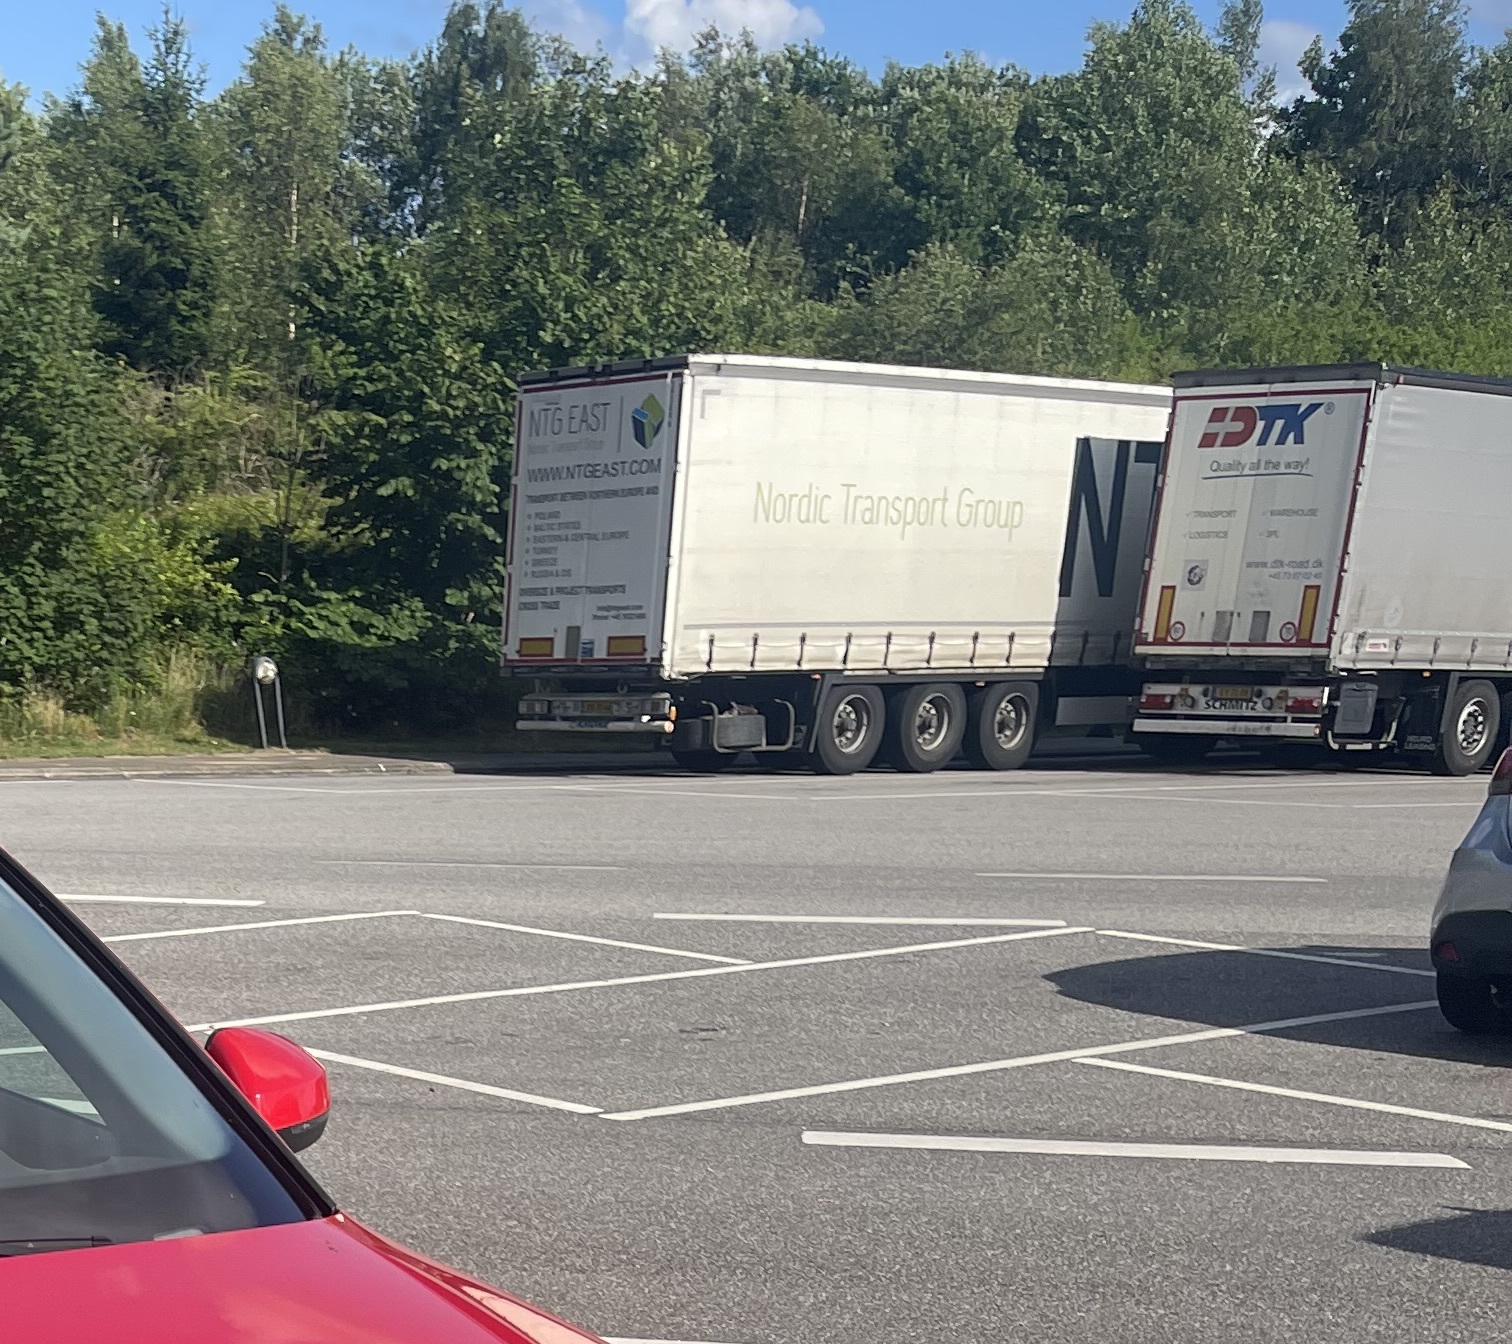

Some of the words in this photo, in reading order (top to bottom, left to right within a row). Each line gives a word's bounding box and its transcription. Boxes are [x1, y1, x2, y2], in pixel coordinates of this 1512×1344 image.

[528, 406, 563, 437] NTG
[568, 402, 612, 435] EAST
[527, 458, 662, 483] WWW.NTGEAST.COM
[1210, 459, 1246, 474] Quality
[1263, 458, 1281, 470] the
[753, 481, 832, 524] Nordic
[841, 483, 949, 541] Transport
[956, 487, 1024, 543] Group
[1204, 699, 1258, 711] SCHMITZ
